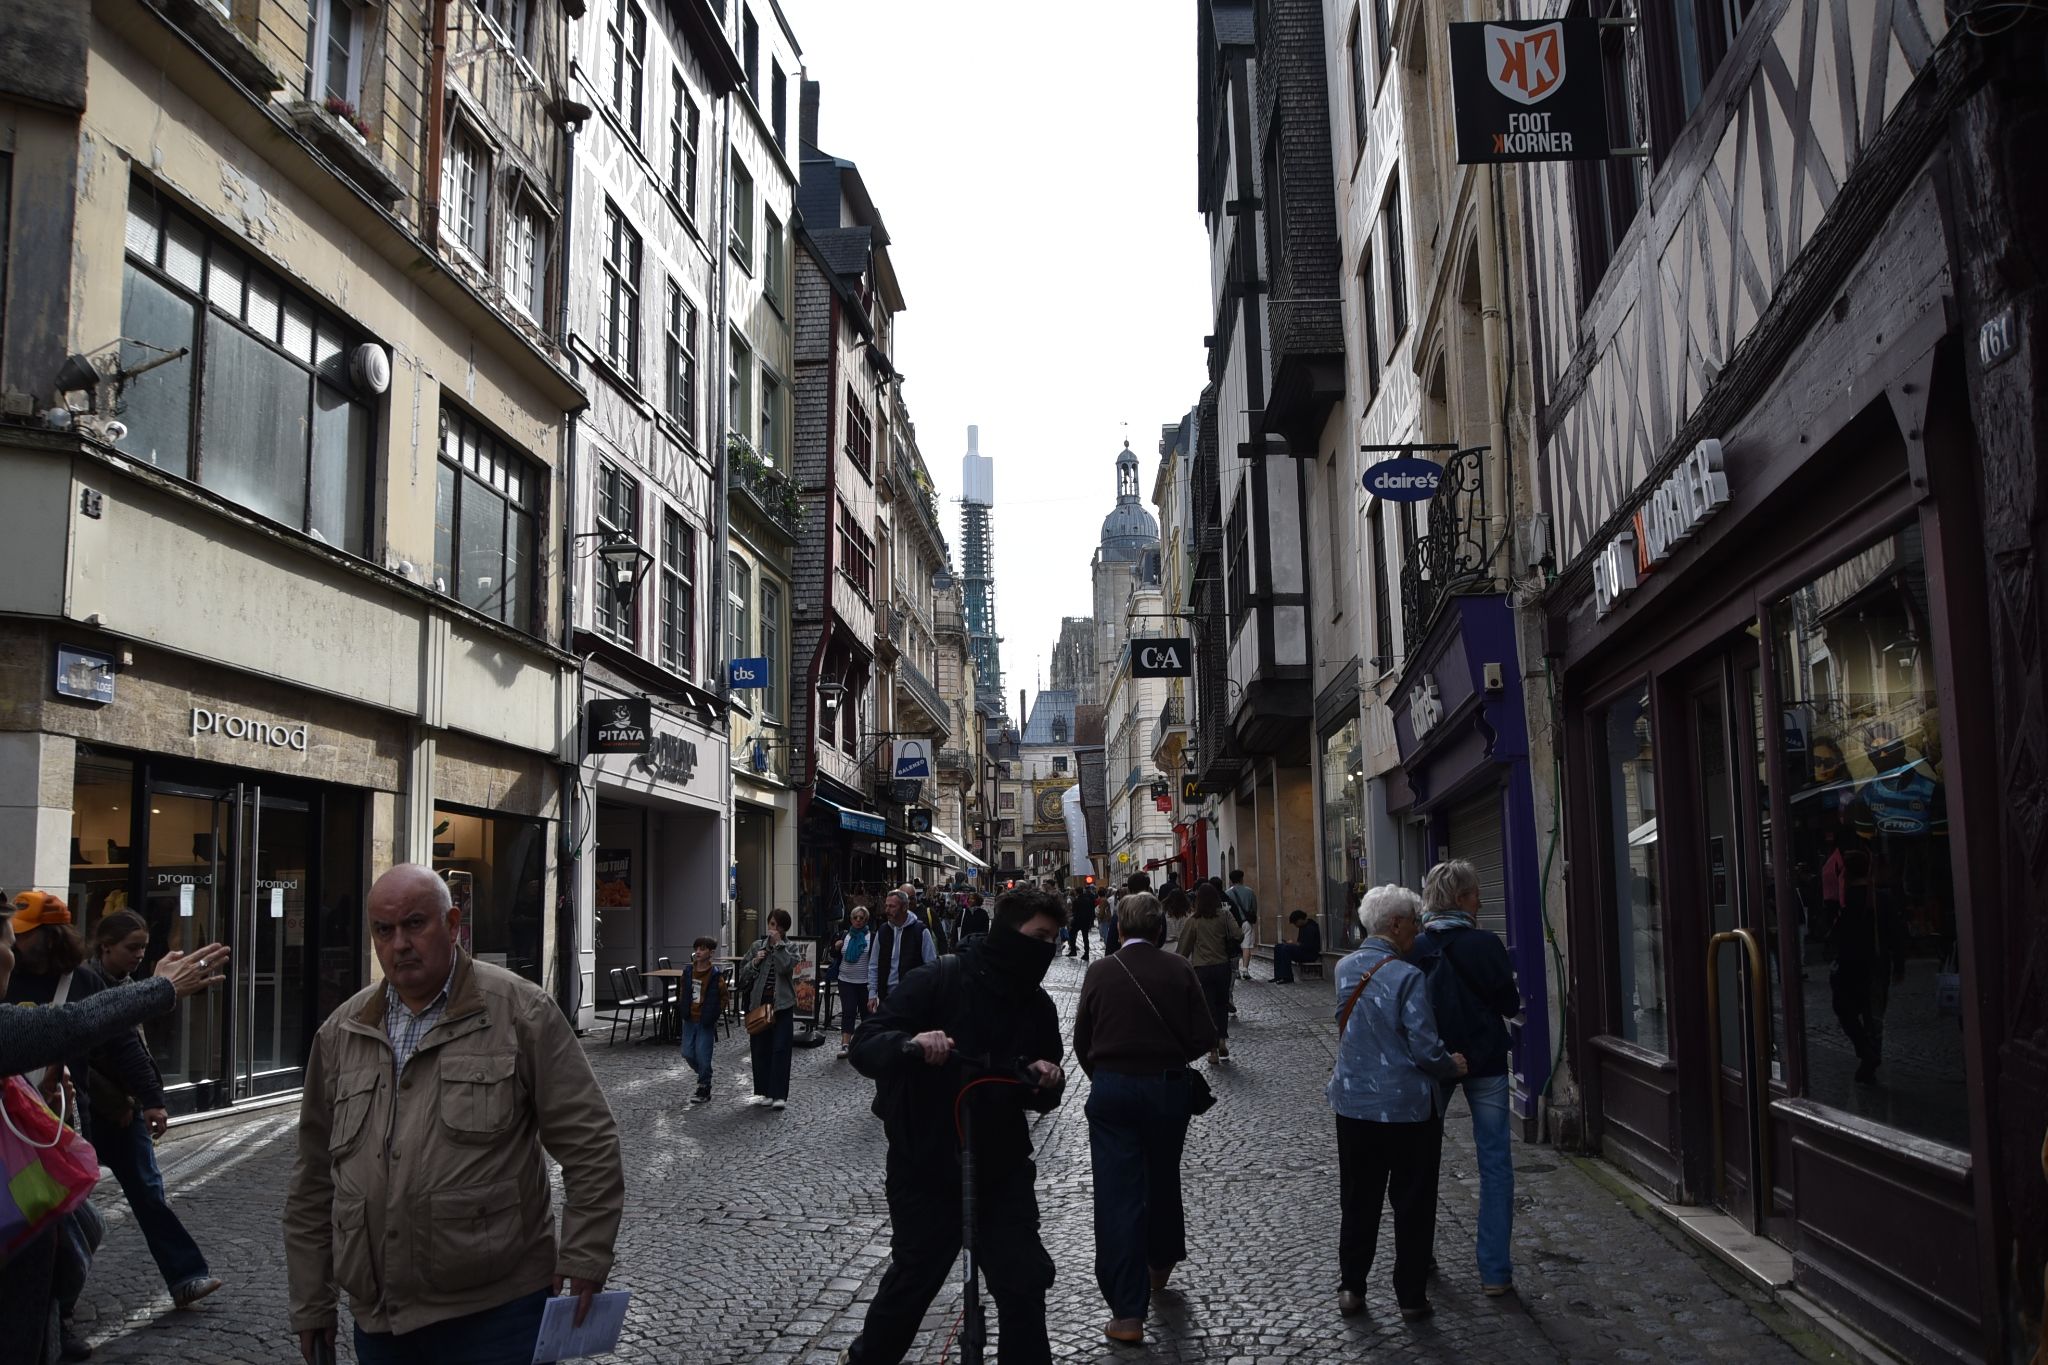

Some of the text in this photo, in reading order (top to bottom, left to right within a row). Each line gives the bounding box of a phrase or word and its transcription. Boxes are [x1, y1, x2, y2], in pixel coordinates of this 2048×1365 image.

[1508, 112, 1551, 133] FOOT
[1980, 317, 2010, 364] 161
[1374, 472, 1438, 489] claire's
[1593, 531, 1637, 616] FOOT
[1140, 646, 1182, 669] C&A
[733, 666, 755, 681] tbs
[191, 707, 307, 750] promod
[598, 730, 645, 741] PITAYA
[158, 873, 213, 885] promod
[256, 879, 298, 890] promod
